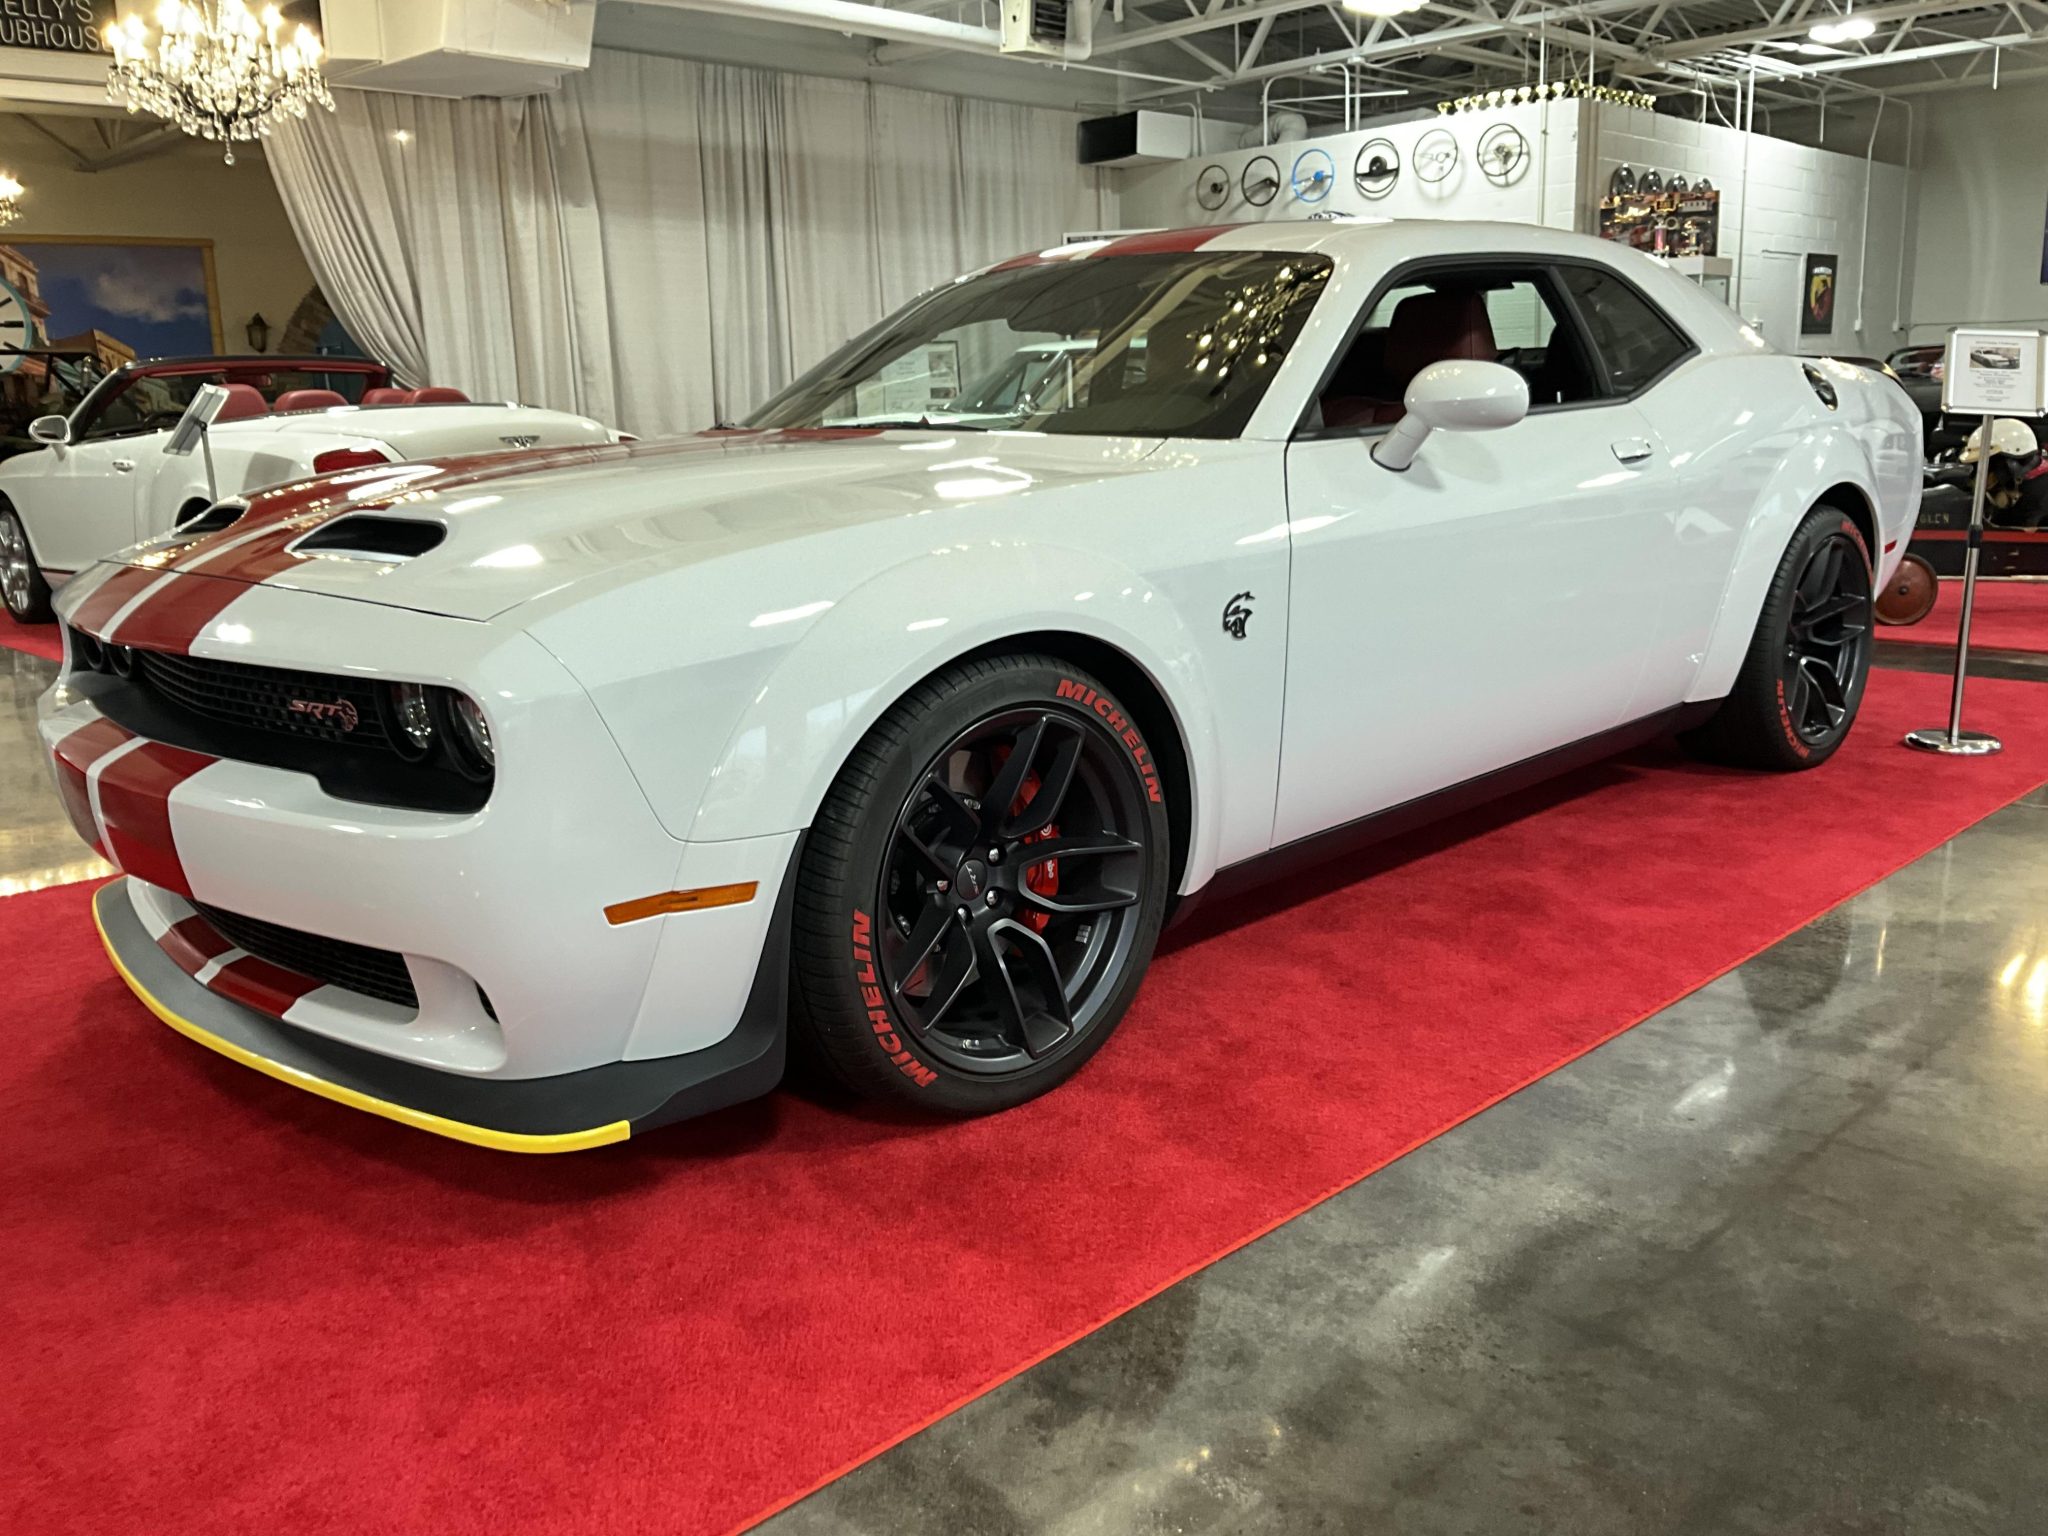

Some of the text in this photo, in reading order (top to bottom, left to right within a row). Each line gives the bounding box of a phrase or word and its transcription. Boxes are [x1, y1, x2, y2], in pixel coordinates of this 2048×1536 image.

[0, 0, 94, 23] ELLY'S
[288, 699, 342, 720] SRT
[1055, 678, 1161, 804] MICHELIN
[852, 908, 939, 1089] MICHELIN
